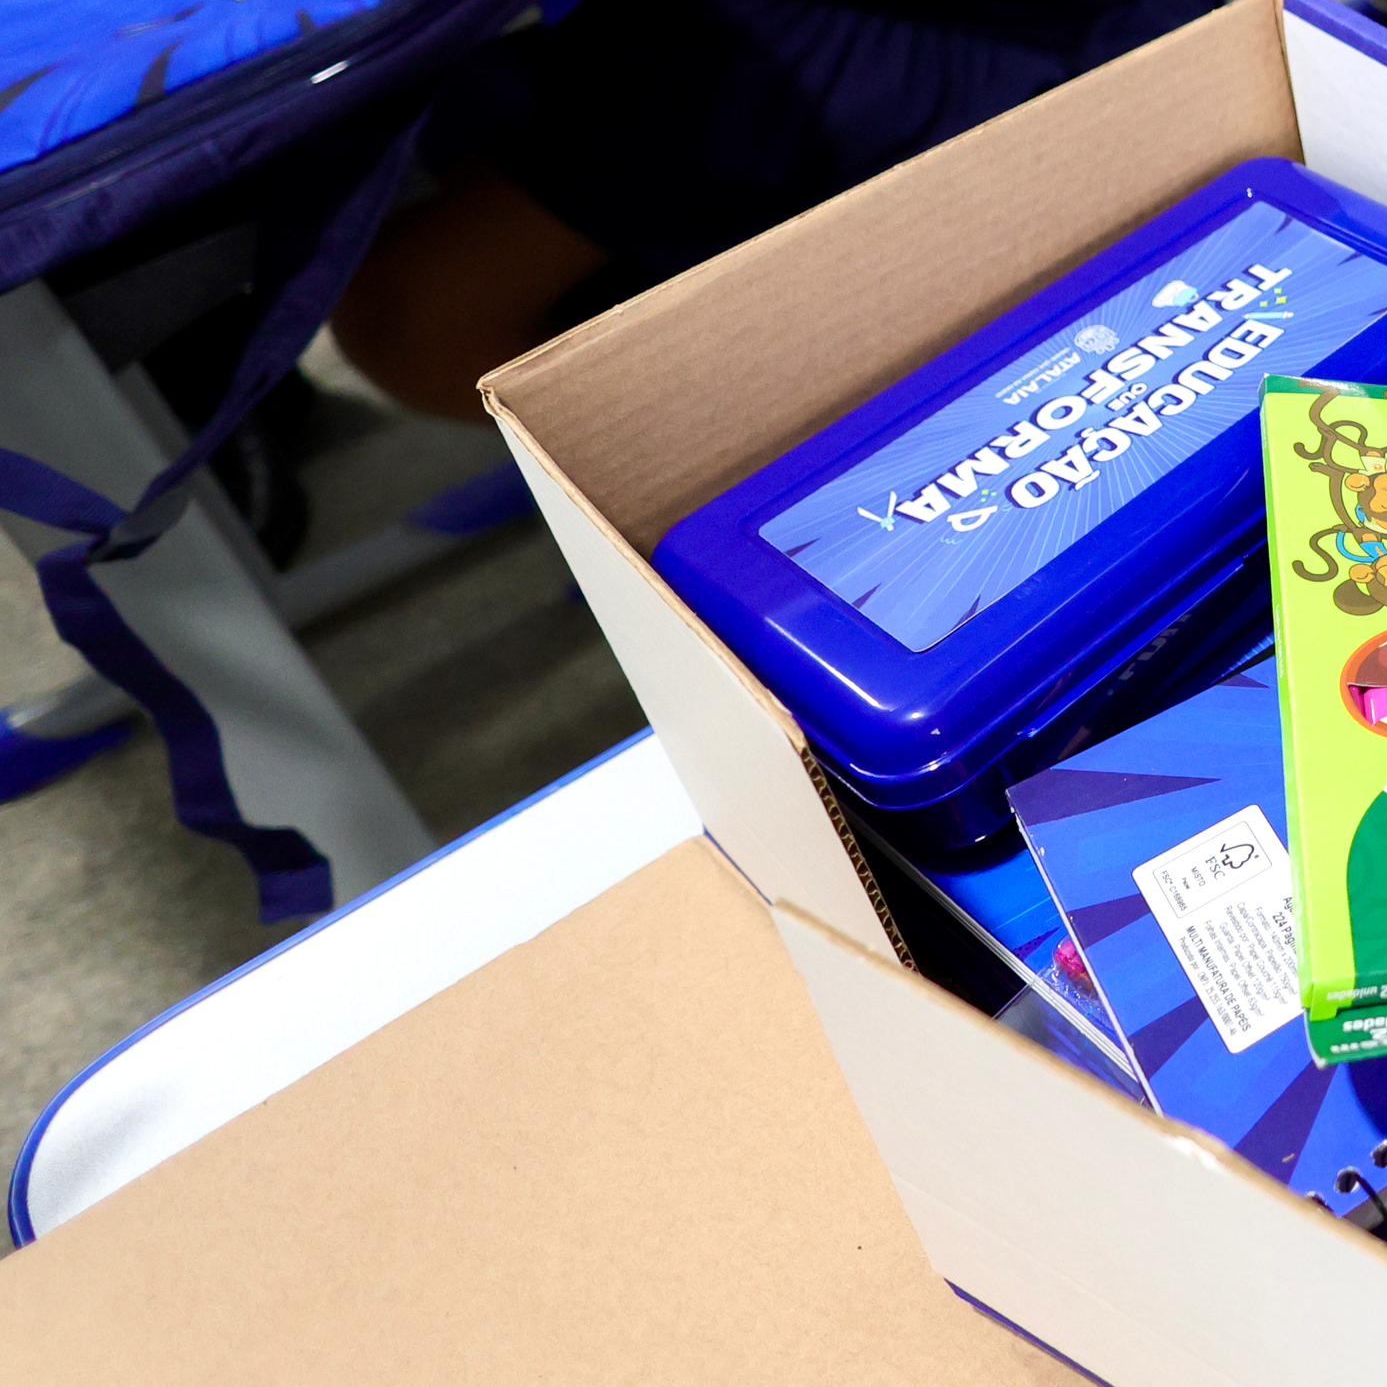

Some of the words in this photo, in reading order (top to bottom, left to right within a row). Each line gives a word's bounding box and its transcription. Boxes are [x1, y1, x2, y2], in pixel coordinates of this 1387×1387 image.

[897, 263, 1292, 524] TRANSFORMA
[1002, 350, 1082, 406] ATALAIA
[1108, 382, 1148, 412] QUE
[1011, 319, 1285, 510] EDUCAÇÃO
[1204, 855, 1225, 881] FSC
[1271, 910, 1288, 928] 224
[1184, 925, 1204, 948] MULTI
[1196, 945, 1230, 994] MANUFATURA
[1223, 992, 1236, 1005] DE
